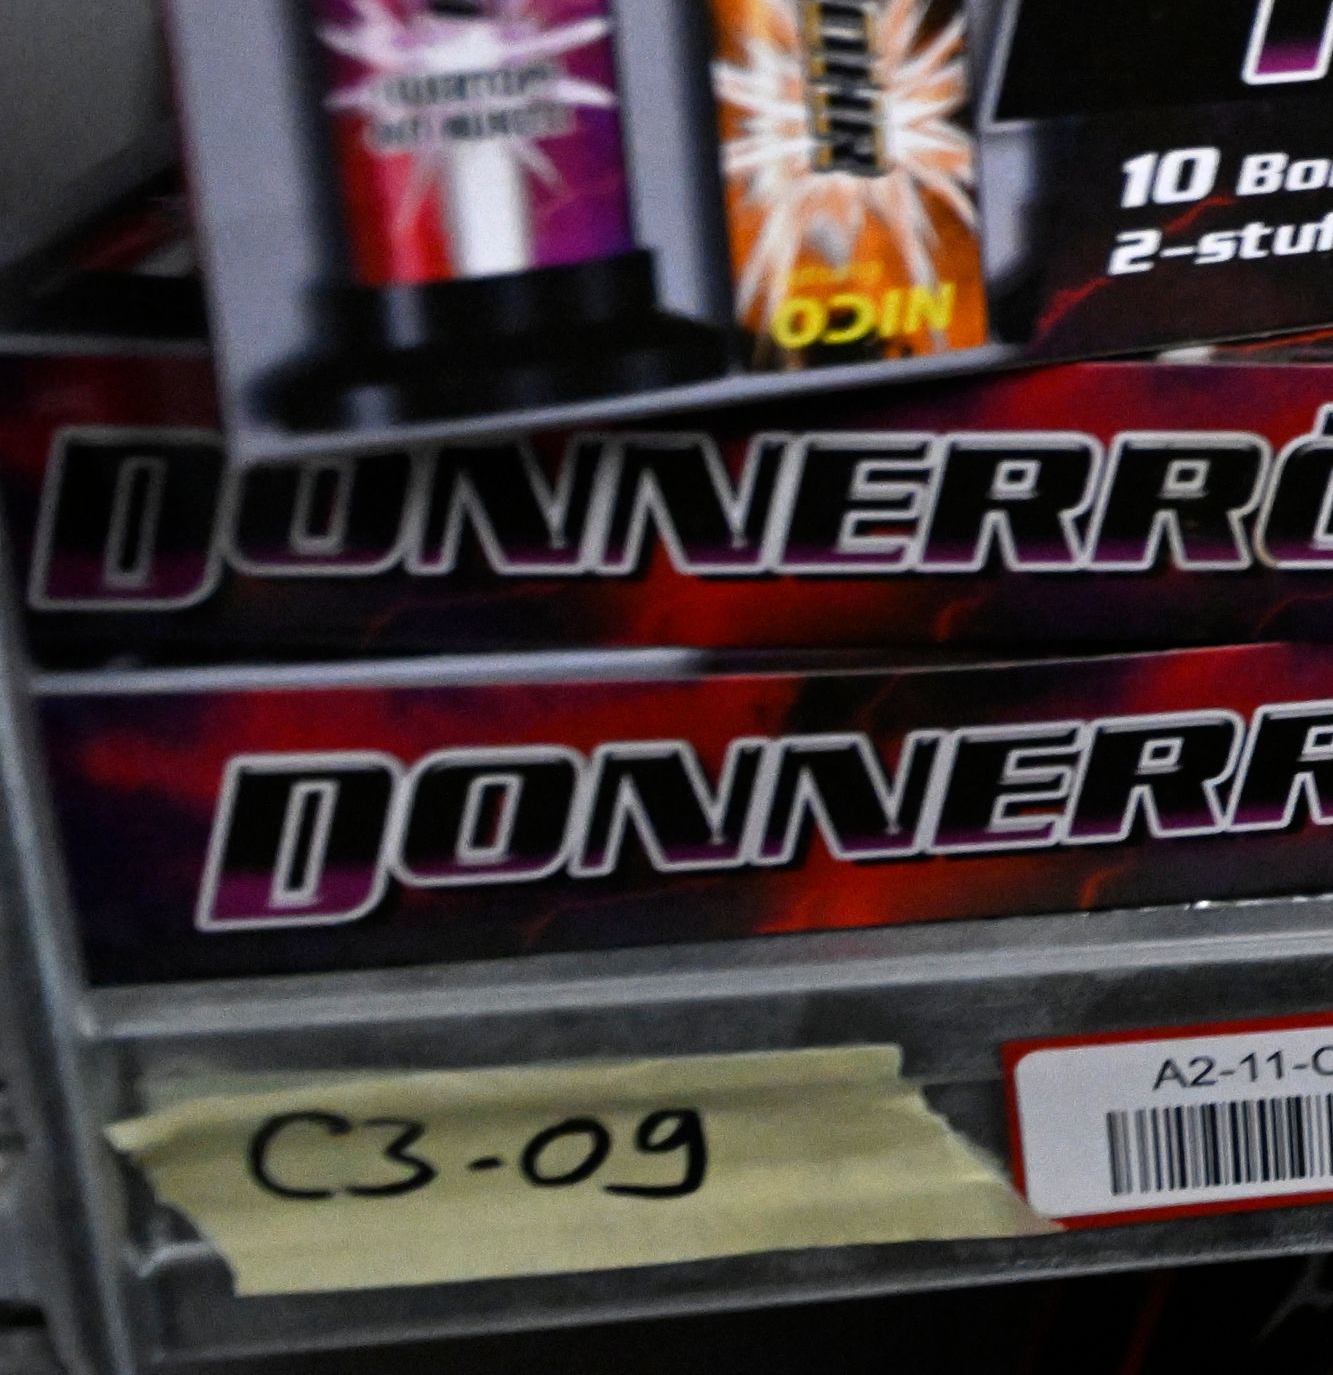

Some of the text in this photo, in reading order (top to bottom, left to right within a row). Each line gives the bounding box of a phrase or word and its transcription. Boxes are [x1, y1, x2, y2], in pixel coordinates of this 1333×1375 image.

[1121, 146, 1220, 209] 10
[772, 281, 956, 349] NICO
[247, 1106, 707, 1200] C3-09
